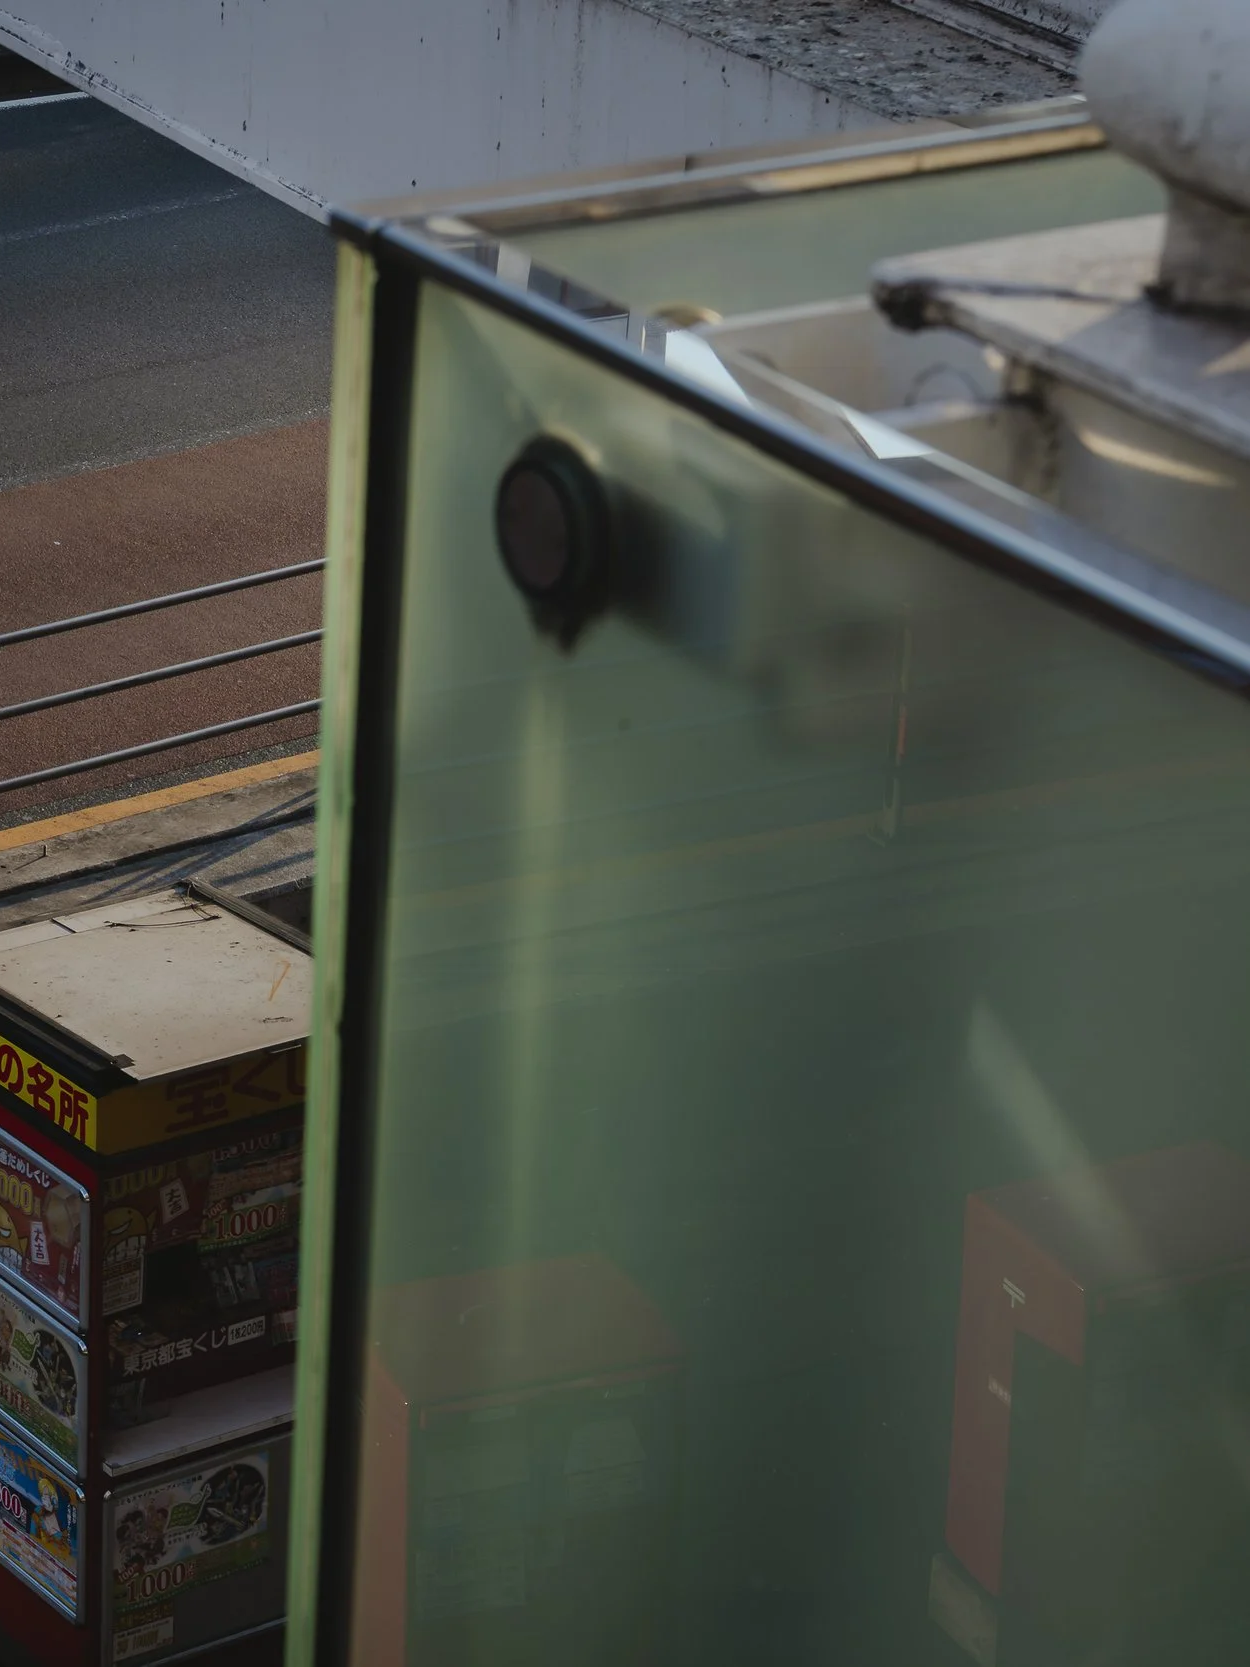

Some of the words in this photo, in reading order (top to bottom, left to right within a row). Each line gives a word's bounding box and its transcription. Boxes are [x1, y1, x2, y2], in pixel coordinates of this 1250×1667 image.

[123, 1326, 226, 1377] 東京都宝くじ
